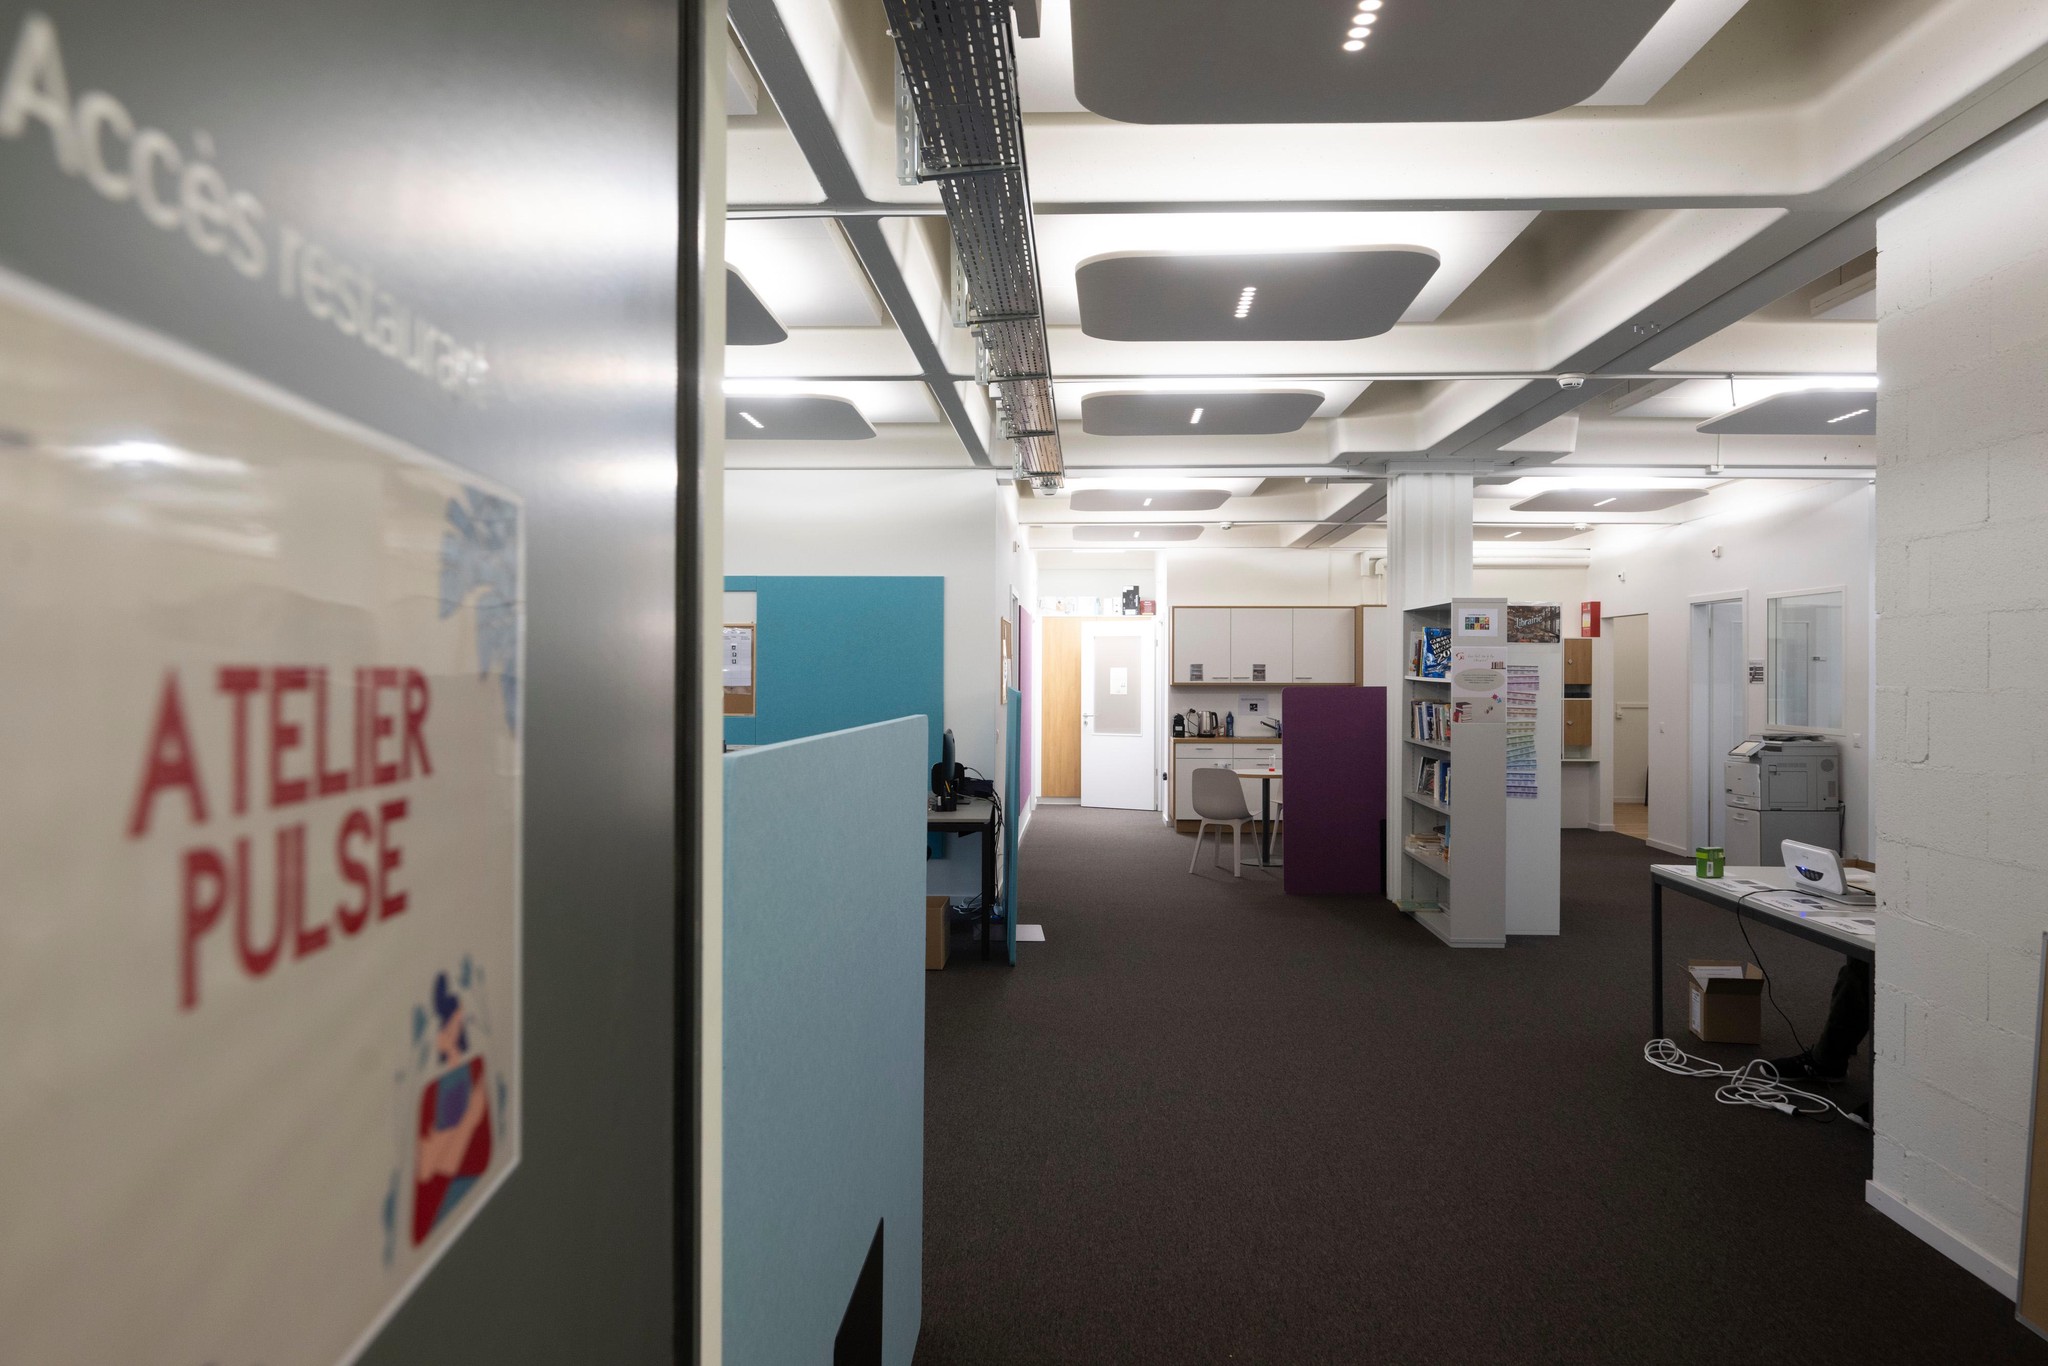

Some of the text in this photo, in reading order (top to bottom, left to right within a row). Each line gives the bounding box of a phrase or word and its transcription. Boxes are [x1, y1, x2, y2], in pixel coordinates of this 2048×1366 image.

[0, 9, 269, 281] Accès
[126, 663, 433, 842] ATELIER
[178, 797, 410, 1012] PULSE
